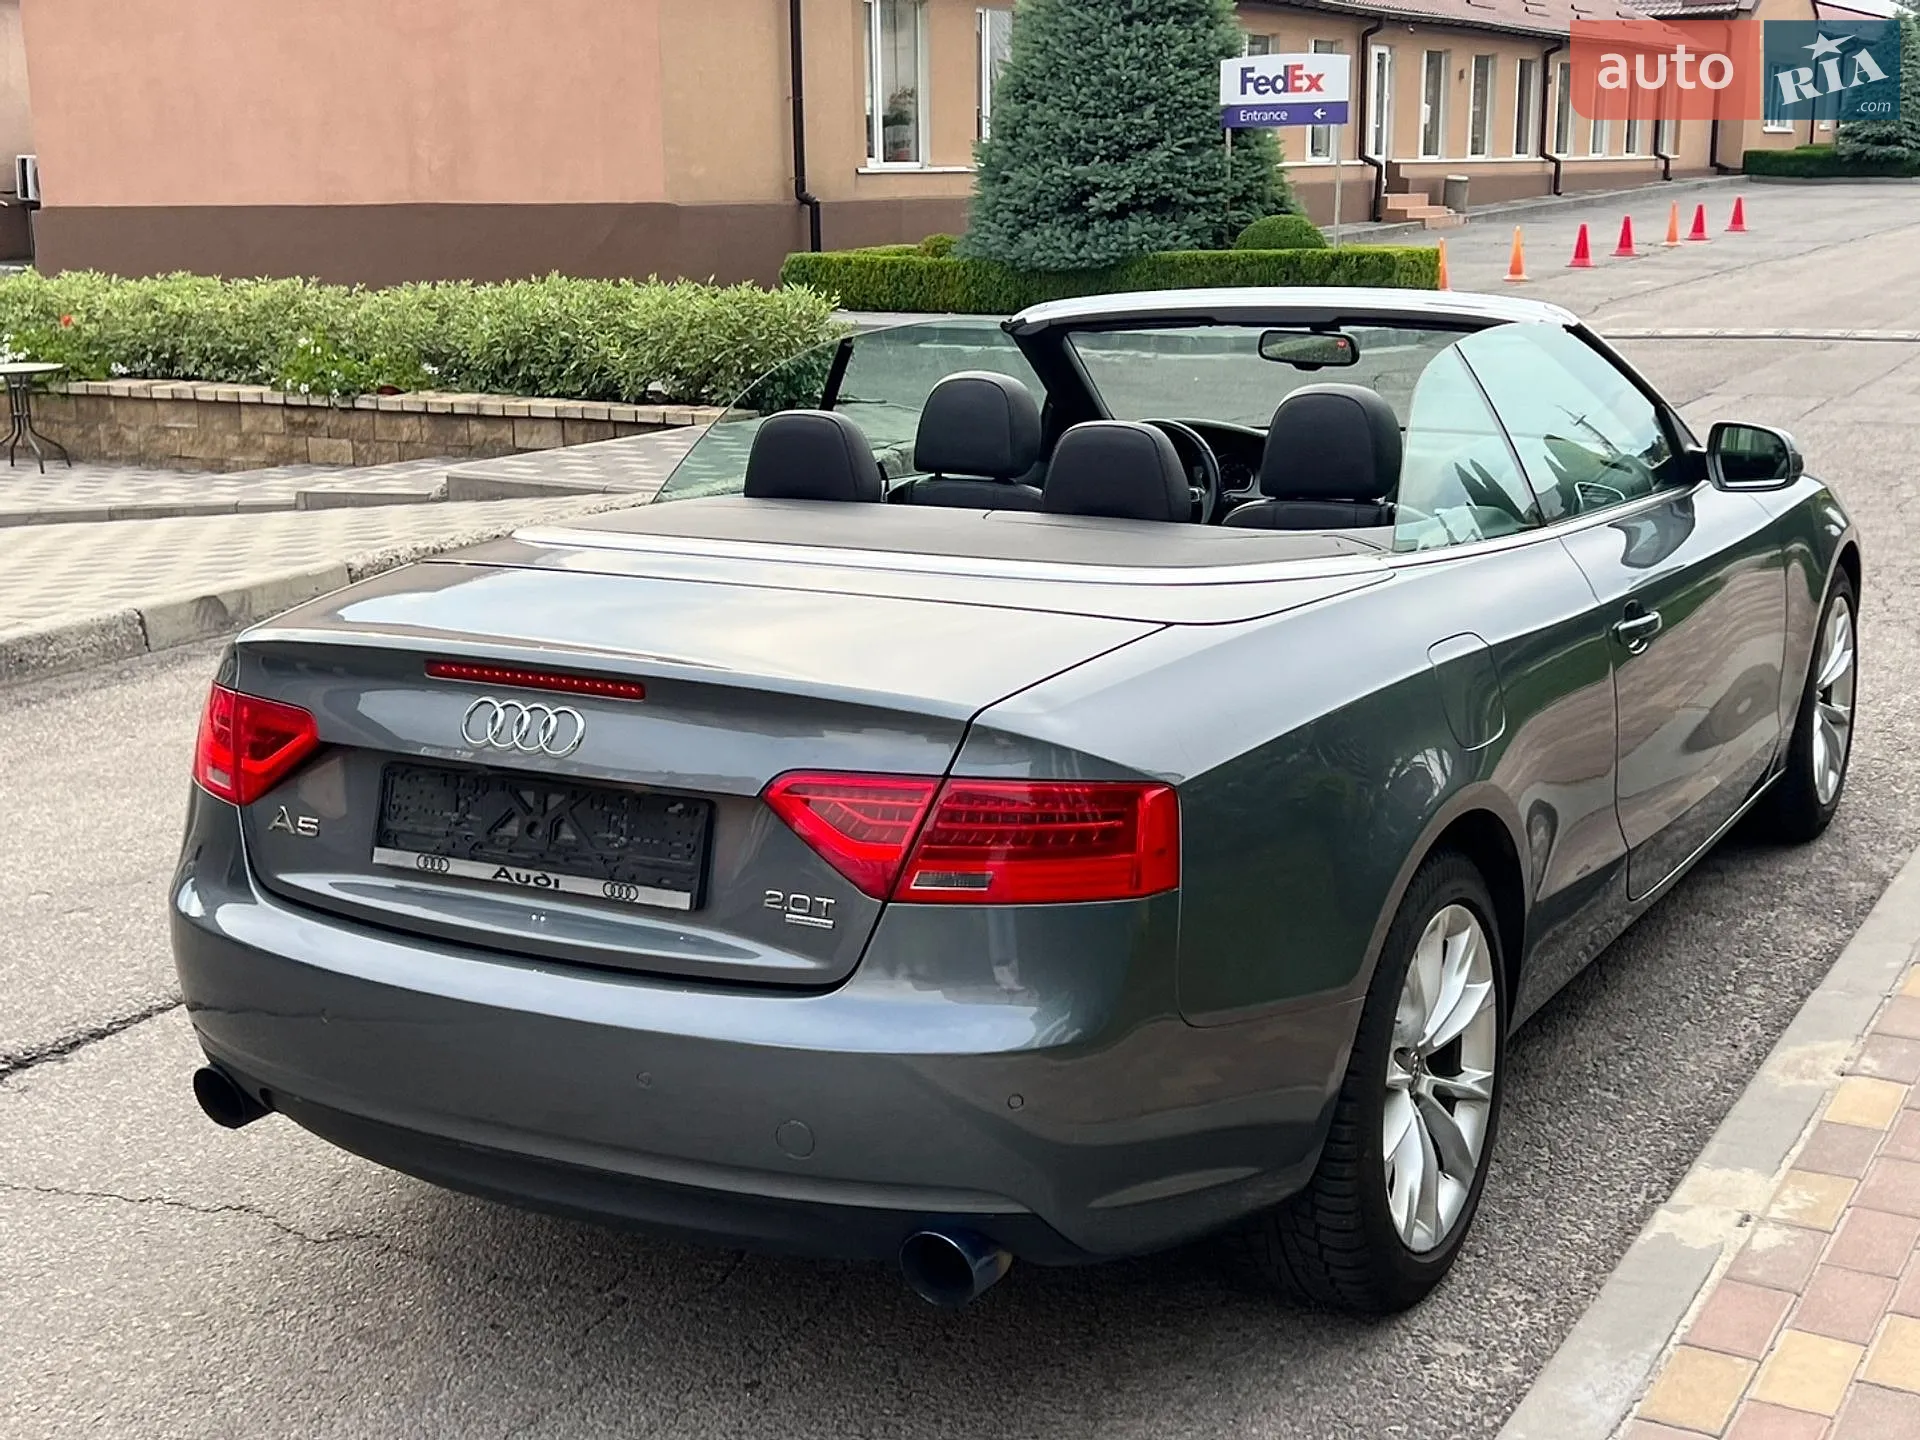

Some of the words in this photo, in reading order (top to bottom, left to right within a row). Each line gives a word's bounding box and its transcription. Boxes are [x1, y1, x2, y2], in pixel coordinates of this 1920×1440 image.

[1240, 64, 1324, 96] FedEx
[1240, 109, 1288, 122] Entrance
[267, 805, 319, 837] A5
[492, 867, 560, 889] Audi
[763, 890, 835, 917] 2.0T
